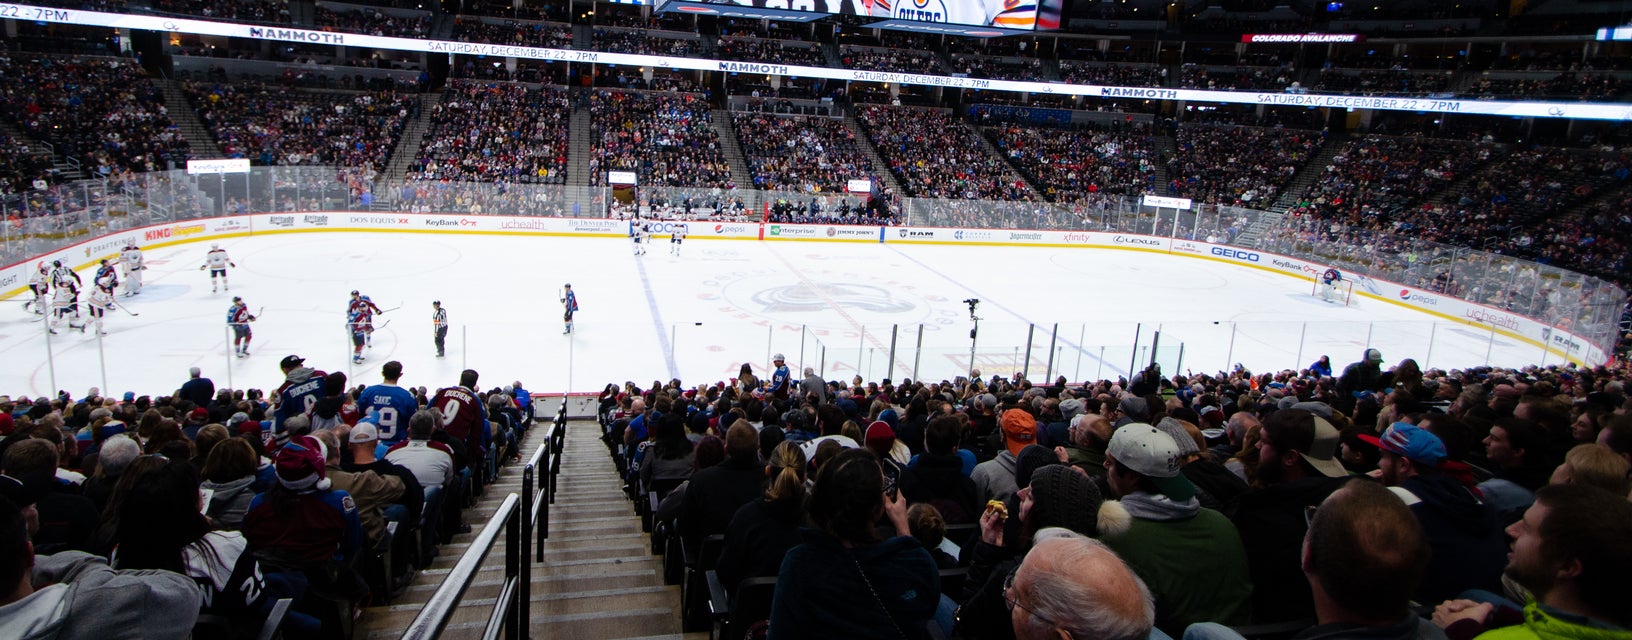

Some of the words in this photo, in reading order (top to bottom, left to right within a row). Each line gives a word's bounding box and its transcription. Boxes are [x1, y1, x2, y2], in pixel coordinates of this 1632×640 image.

[0, 5, 18, 18] 22
[34, 9, 69, 21] 7PM
[250, 27, 344, 44] MAMMOTH
[1251, 35, 1301, 43] COLORADO
[1301, 34, 1355, 43] AVALANCHE
[428, 41, 489, 56] SATURDAY,
[490, 46, 552, 60] DECEMBER
[554, 50, 567, 61] 22
[576, 51, 598, 62] 7PM
[719, 61, 788, 75] MAMMOTH
[903, 74, 952, 87] DECEMBER
[953, 77, 964, 87] 22
[971, 79, 990, 89] 7PM
[1101, 87, 1177, 99] MAMMOTH
[1257, 93, 1321, 106] SATURDAY,
[1325, 96, 1398, 110] DECEMBER
[1401, 99, 1417, 110] 22
[1430, 100, 1460, 112] 7PM
[370, 217, 396, 225] EQUIS
[425, 219, 459, 227] KeyBank
[501, 219, 545, 230] uchealth
[145, 228, 171, 241] KING
[725, 226, 745, 234] pepsi
[1063, 233, 1090, 243] xfinity
[1125, 238, 1160, 246] LEXUS
[1211, 247, 1260, 262] GEICO
[1272, 259, 1301, 271] KeyBank
[1411, 294, 1437, 305] pepsi
[1466, 307, 1519, 331] uchealth
[289, 377, 320, 397] DUCHENE
[444, 390, 472, 405] DUCHENE
